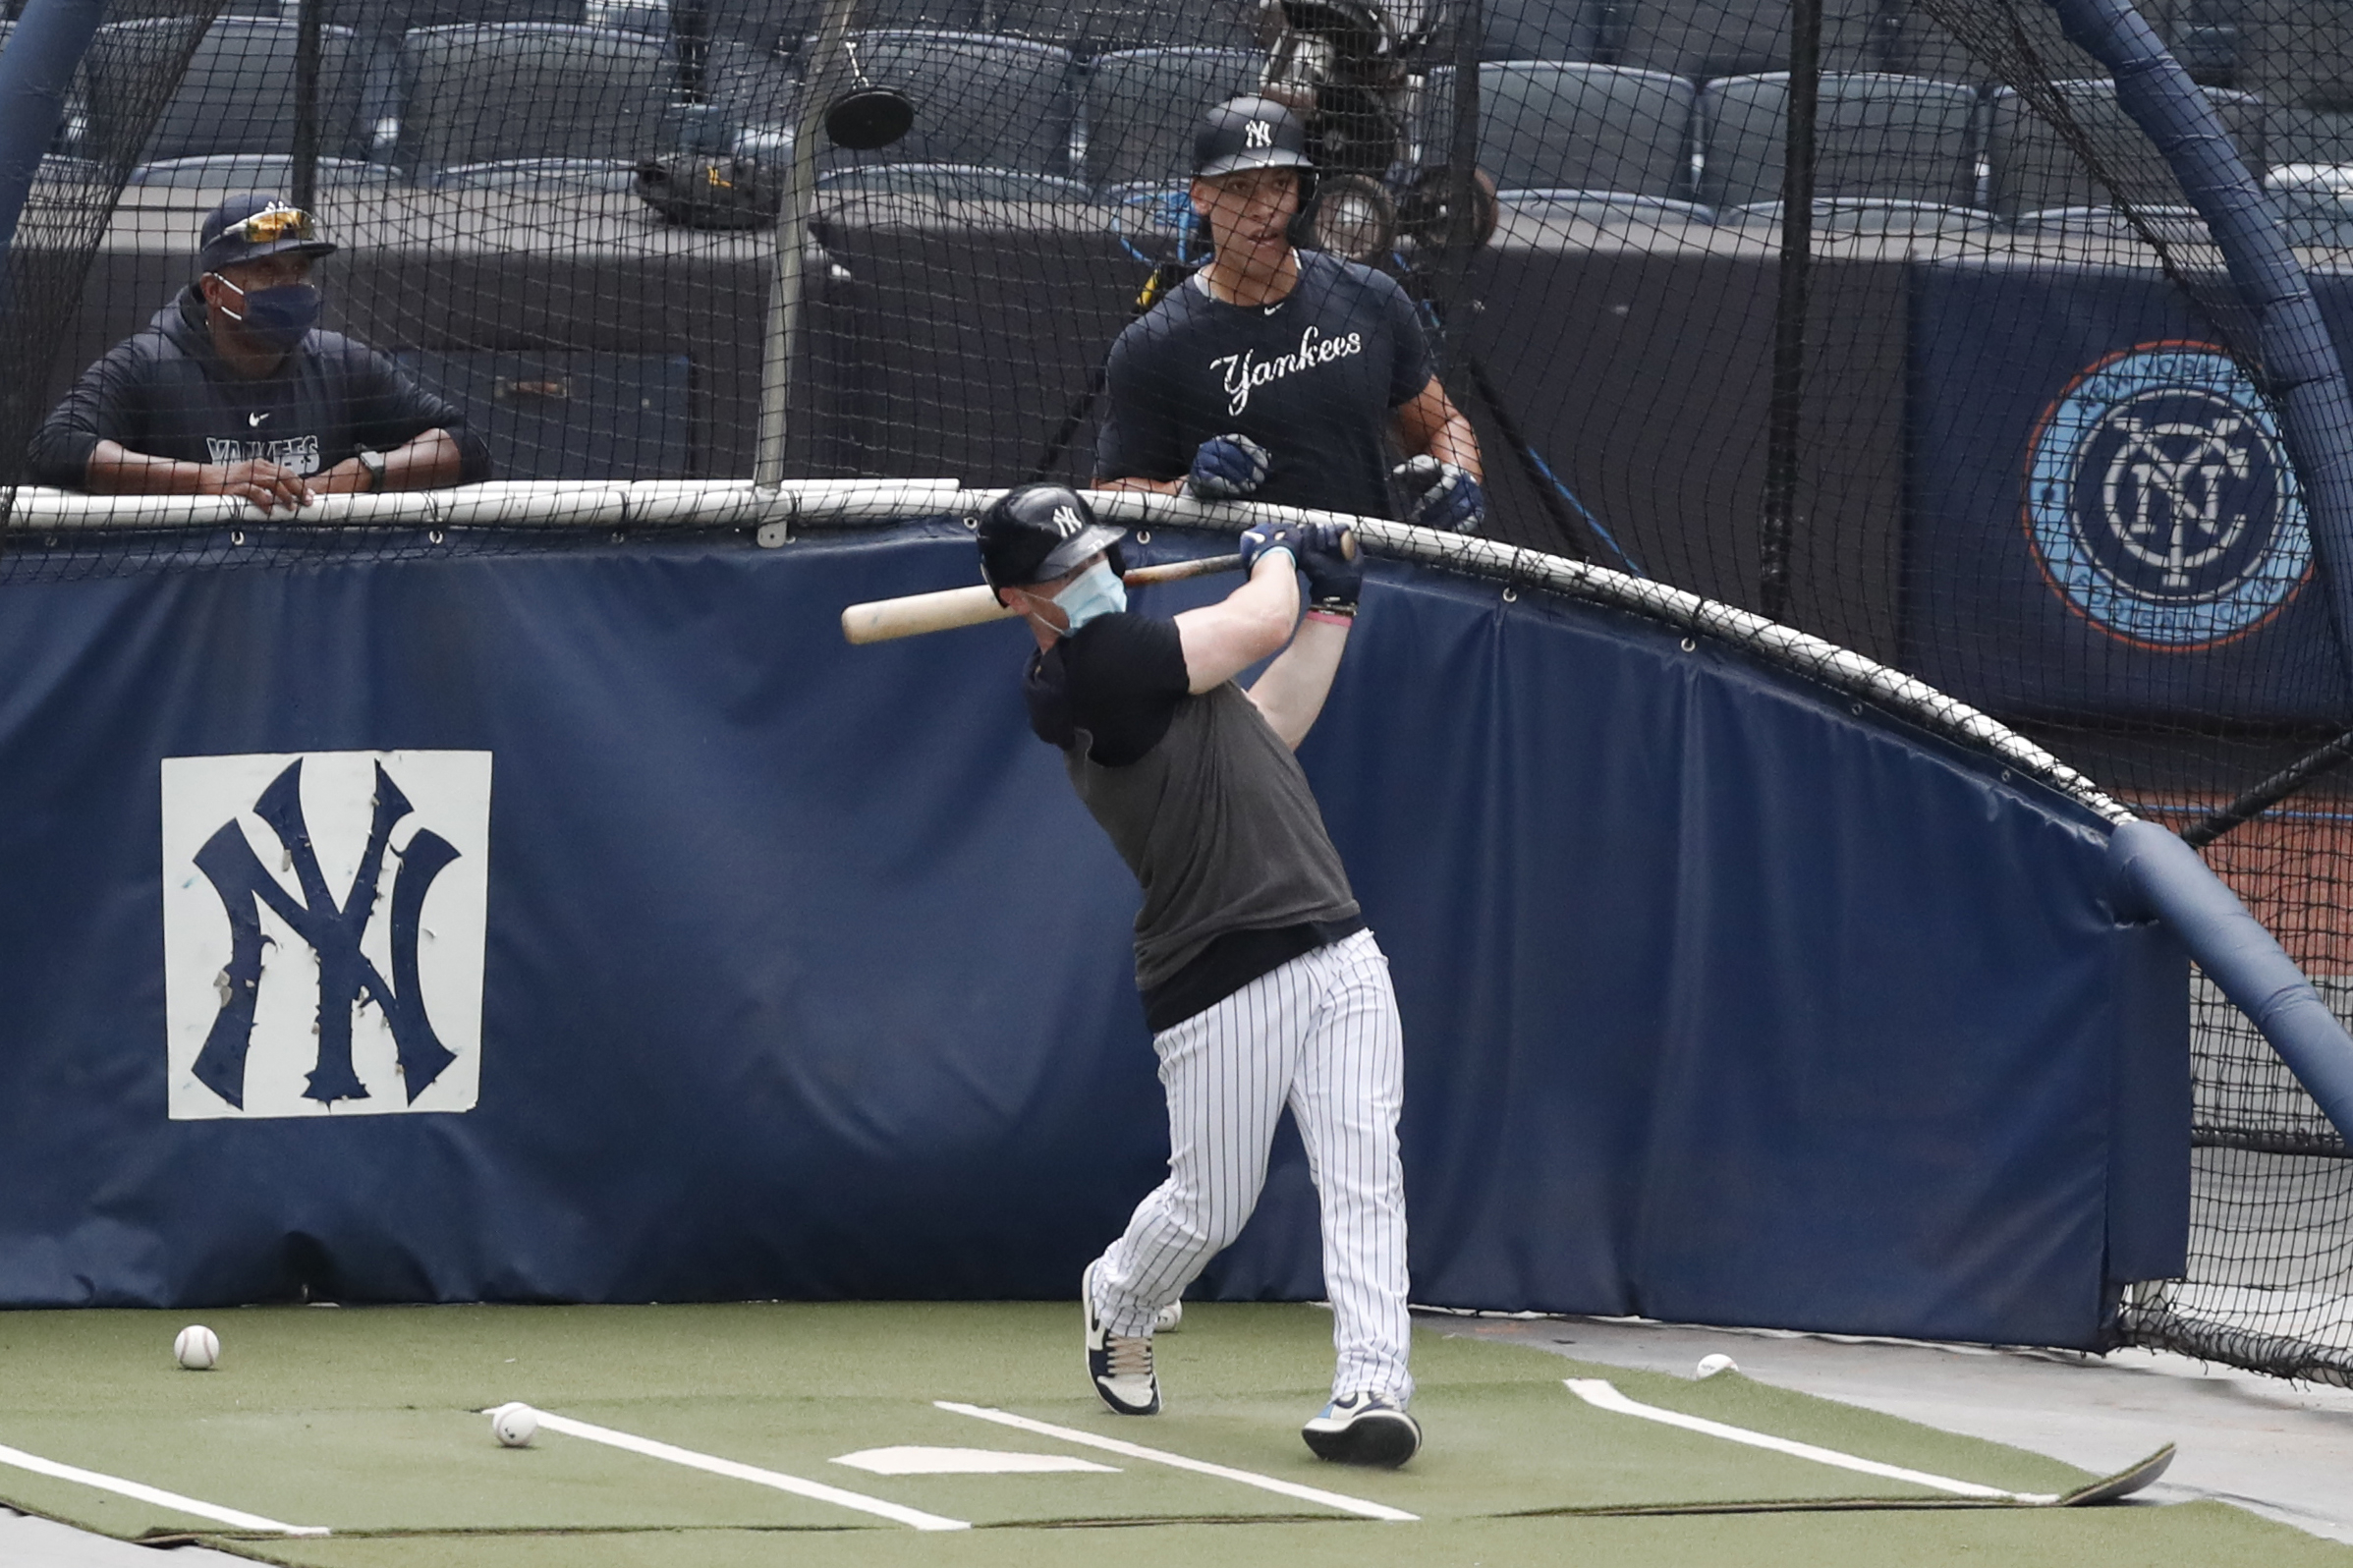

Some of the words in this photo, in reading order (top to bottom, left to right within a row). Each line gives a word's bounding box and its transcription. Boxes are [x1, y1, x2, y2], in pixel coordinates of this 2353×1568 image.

[1245, 119, 1272, 148] NY
[1209, 325, 1361, 416] Yankees
[1053, 506, 1082, 538] NY
[192, 756, 463, 1112] NY
